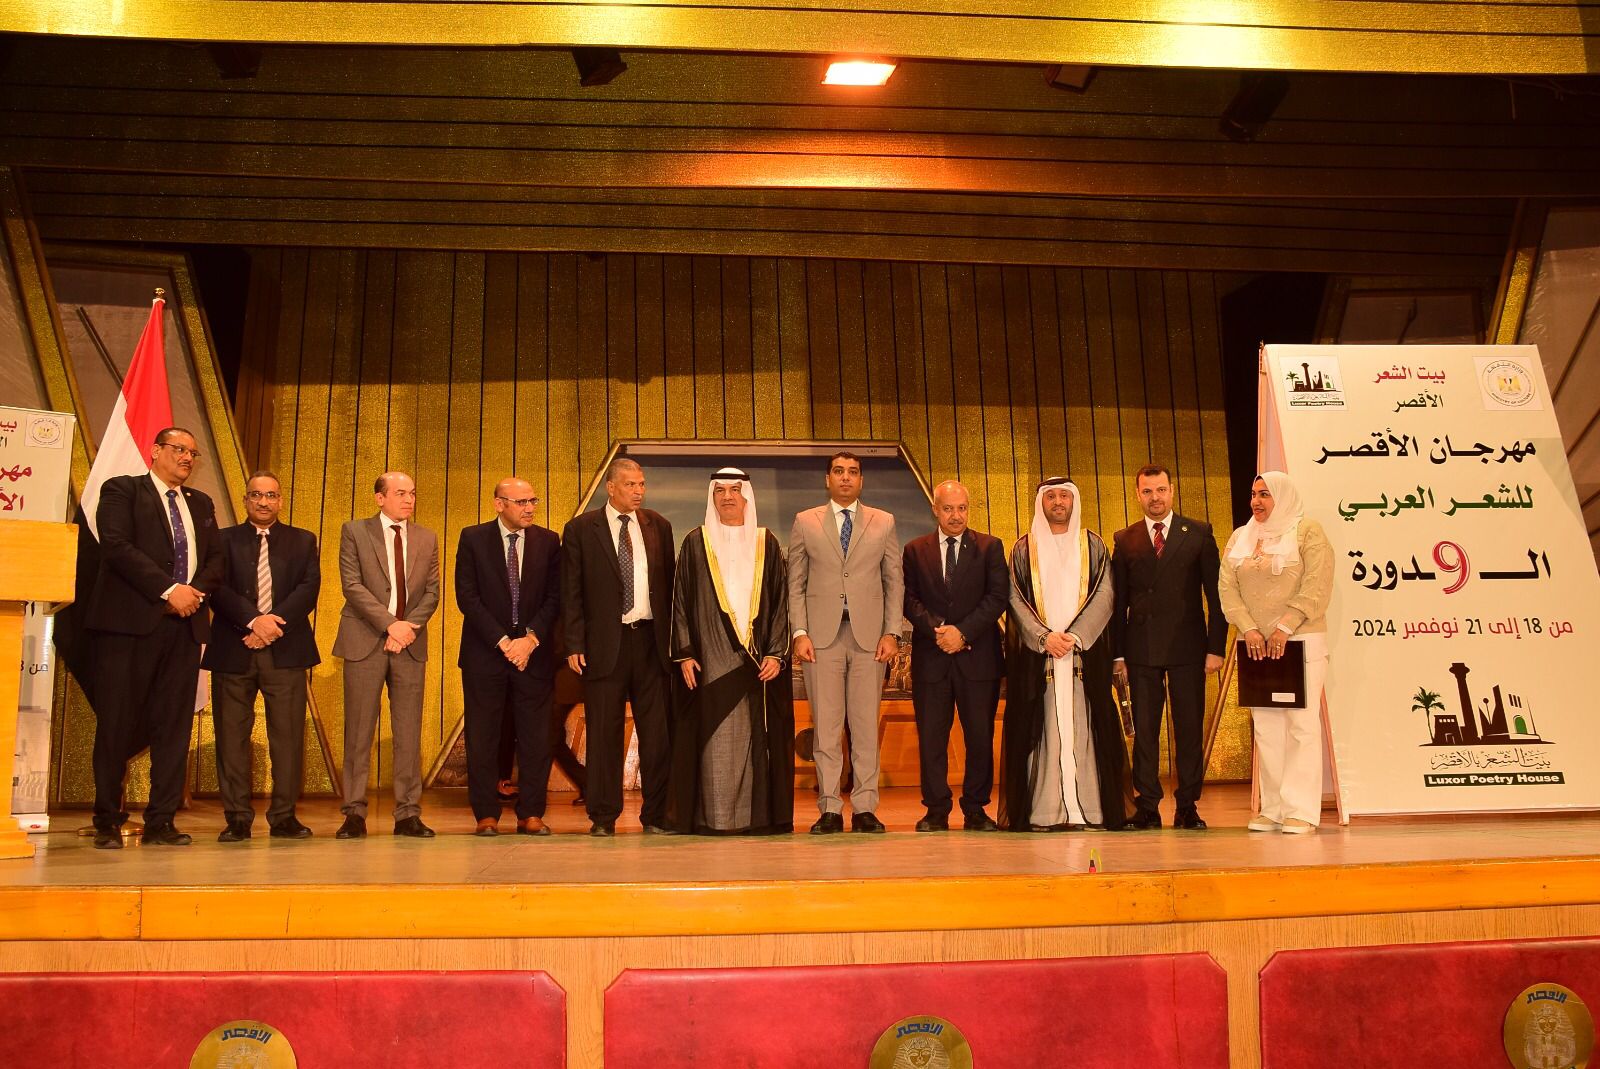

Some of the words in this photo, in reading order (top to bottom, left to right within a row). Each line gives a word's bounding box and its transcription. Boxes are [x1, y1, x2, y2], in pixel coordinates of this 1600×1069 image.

[1372, 367, 1413, 384] الشعر
[1417, 366, 1446, 384] بيت
[1392, 390, 1444, 412] الأقصر
[1312, 428, 1419, 464] الأقصر
[1430, 436, 1536, 464] مهرجان
[1338, 486, 1435, 522] العربي
[1442, 484, 1534, 516] للشعر
[1432, 540, 1471, 595] 9
[1352, 618, 1396, 638] 2024
[1402, 618, 1459, 640] نوفمبر
[1465, 618, 1483, 636] 21
[1489, 616, 1522, 640] إلى
[1524, 618, 1542, 634] 18
[1549, 622, 1574, 638] من
[1428, 775, 1466, 785] Luxor
[1470, 774, 1514, 785] Poetry
[1517, 773, 1560, 783] House
